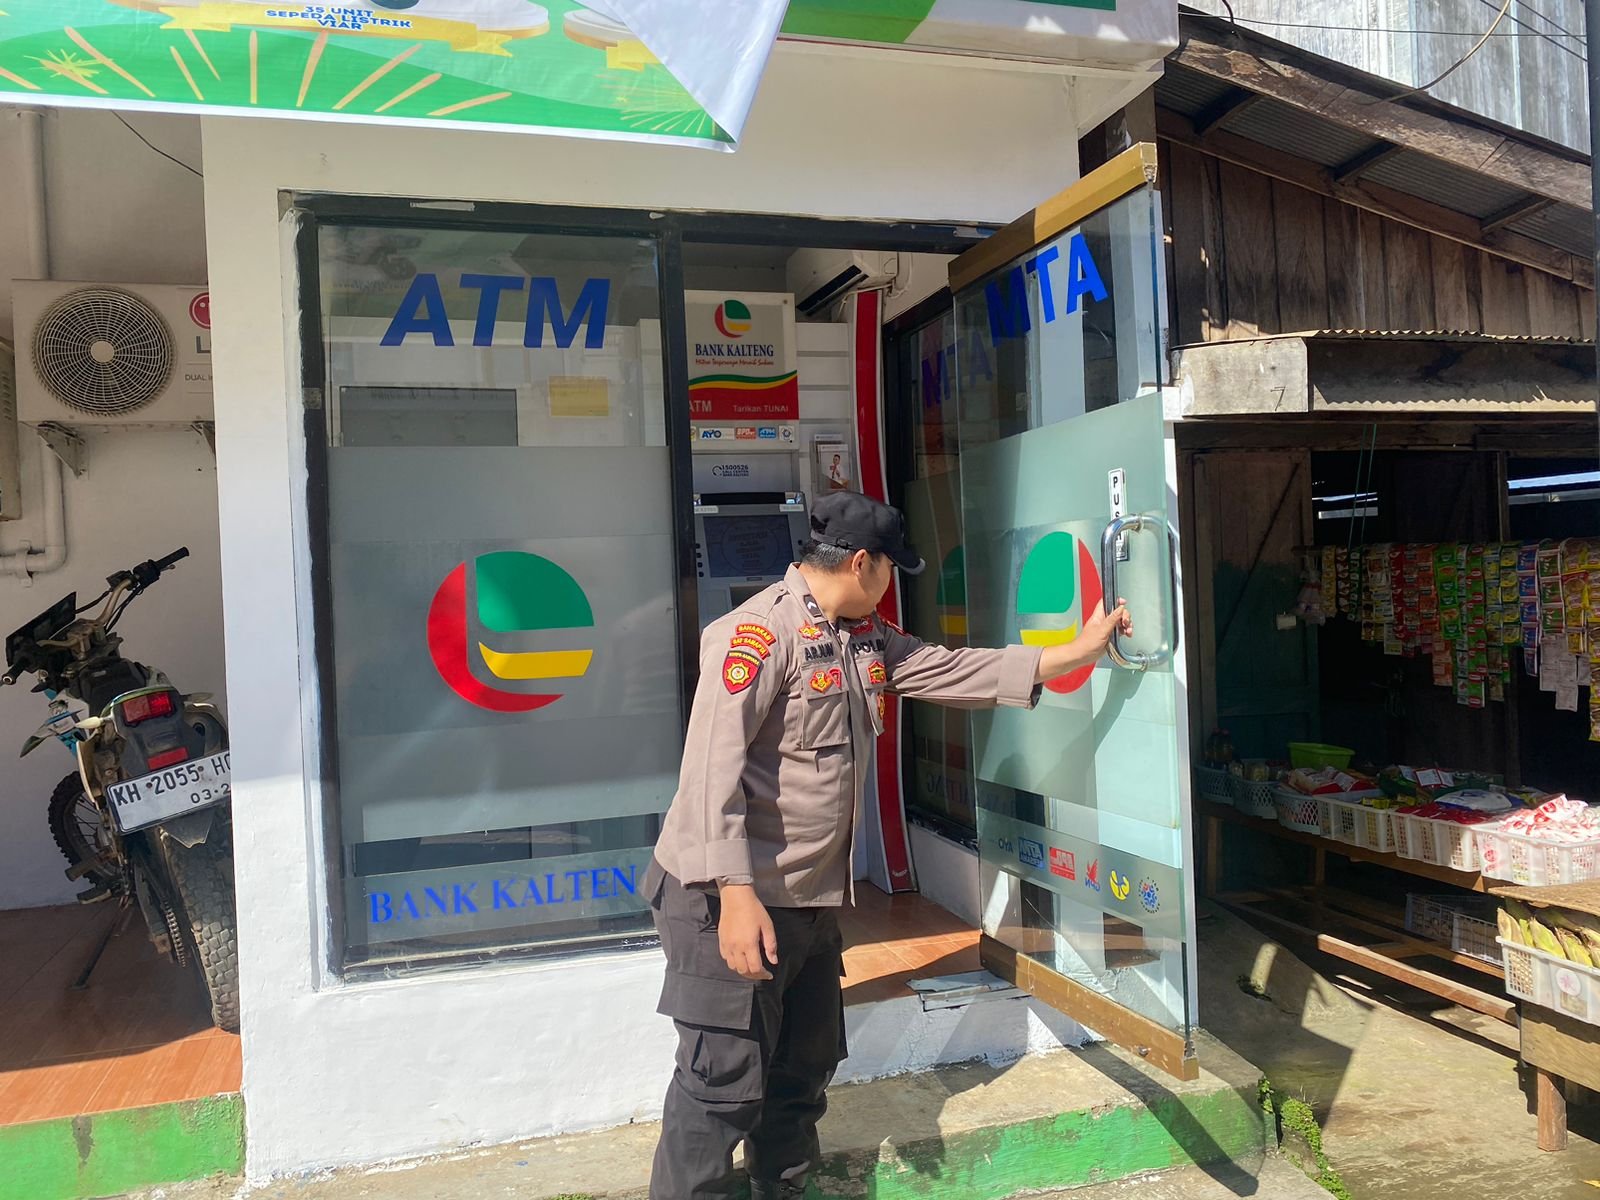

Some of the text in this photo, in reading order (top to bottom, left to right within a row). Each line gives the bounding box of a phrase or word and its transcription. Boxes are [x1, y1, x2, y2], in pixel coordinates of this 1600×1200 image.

[266, 10, 411, 28] SEPEDA LISTRIK
[305, 6, 373, 18] 35 UNIT
[317, 19, 363, 30] VIAR
[379, 273, 611, 349] ATM
[695, 343, 774, 357] BANK KALTENG
[688, 400, 789, 413] ATM Tarikan TUNAI
[113, 783, 141, 806] KH
[151, 764, 200, 794] 2055
[368, 864, 637, 924] BANK KALTEN
